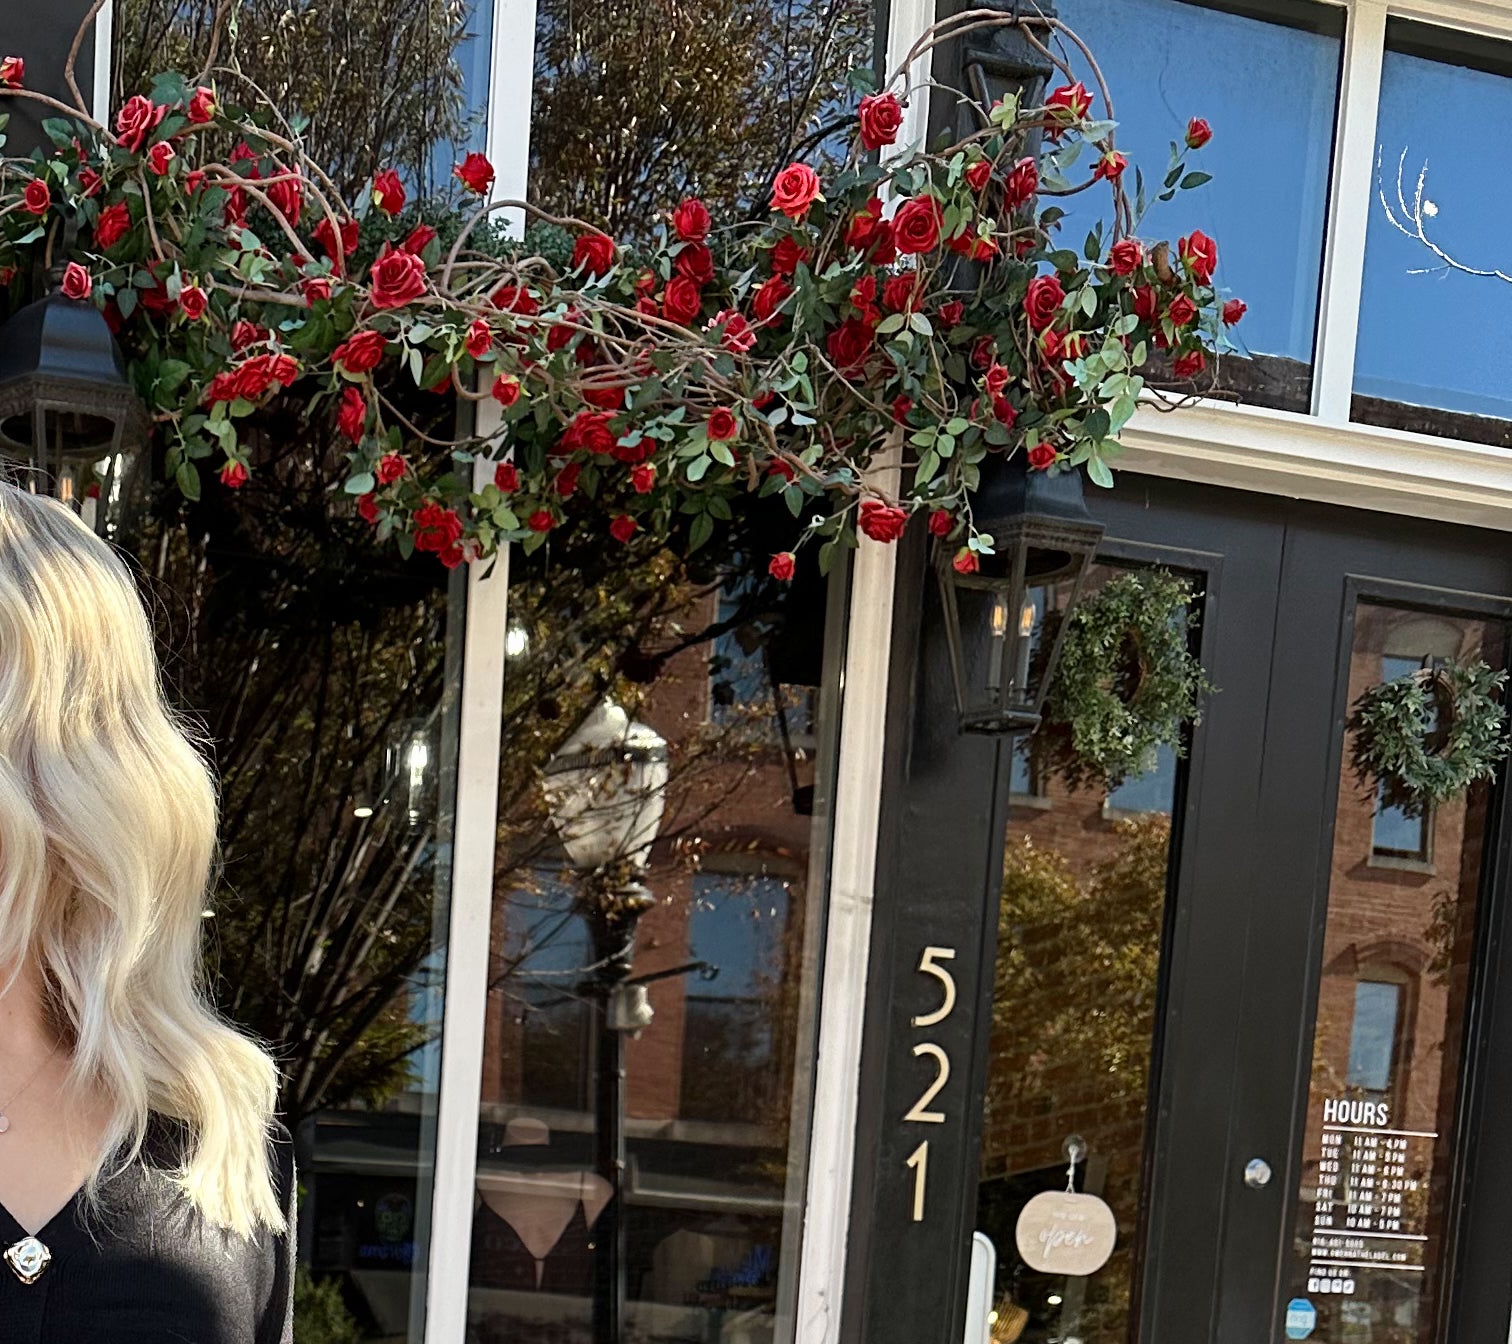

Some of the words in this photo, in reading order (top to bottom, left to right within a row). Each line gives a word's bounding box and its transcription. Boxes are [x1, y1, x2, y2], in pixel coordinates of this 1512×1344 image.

[903, 946, 956, 1222] 521
[1323, 1098, 1388, 1126] HOURS
[1038, 1222, 1095, 1259] open
